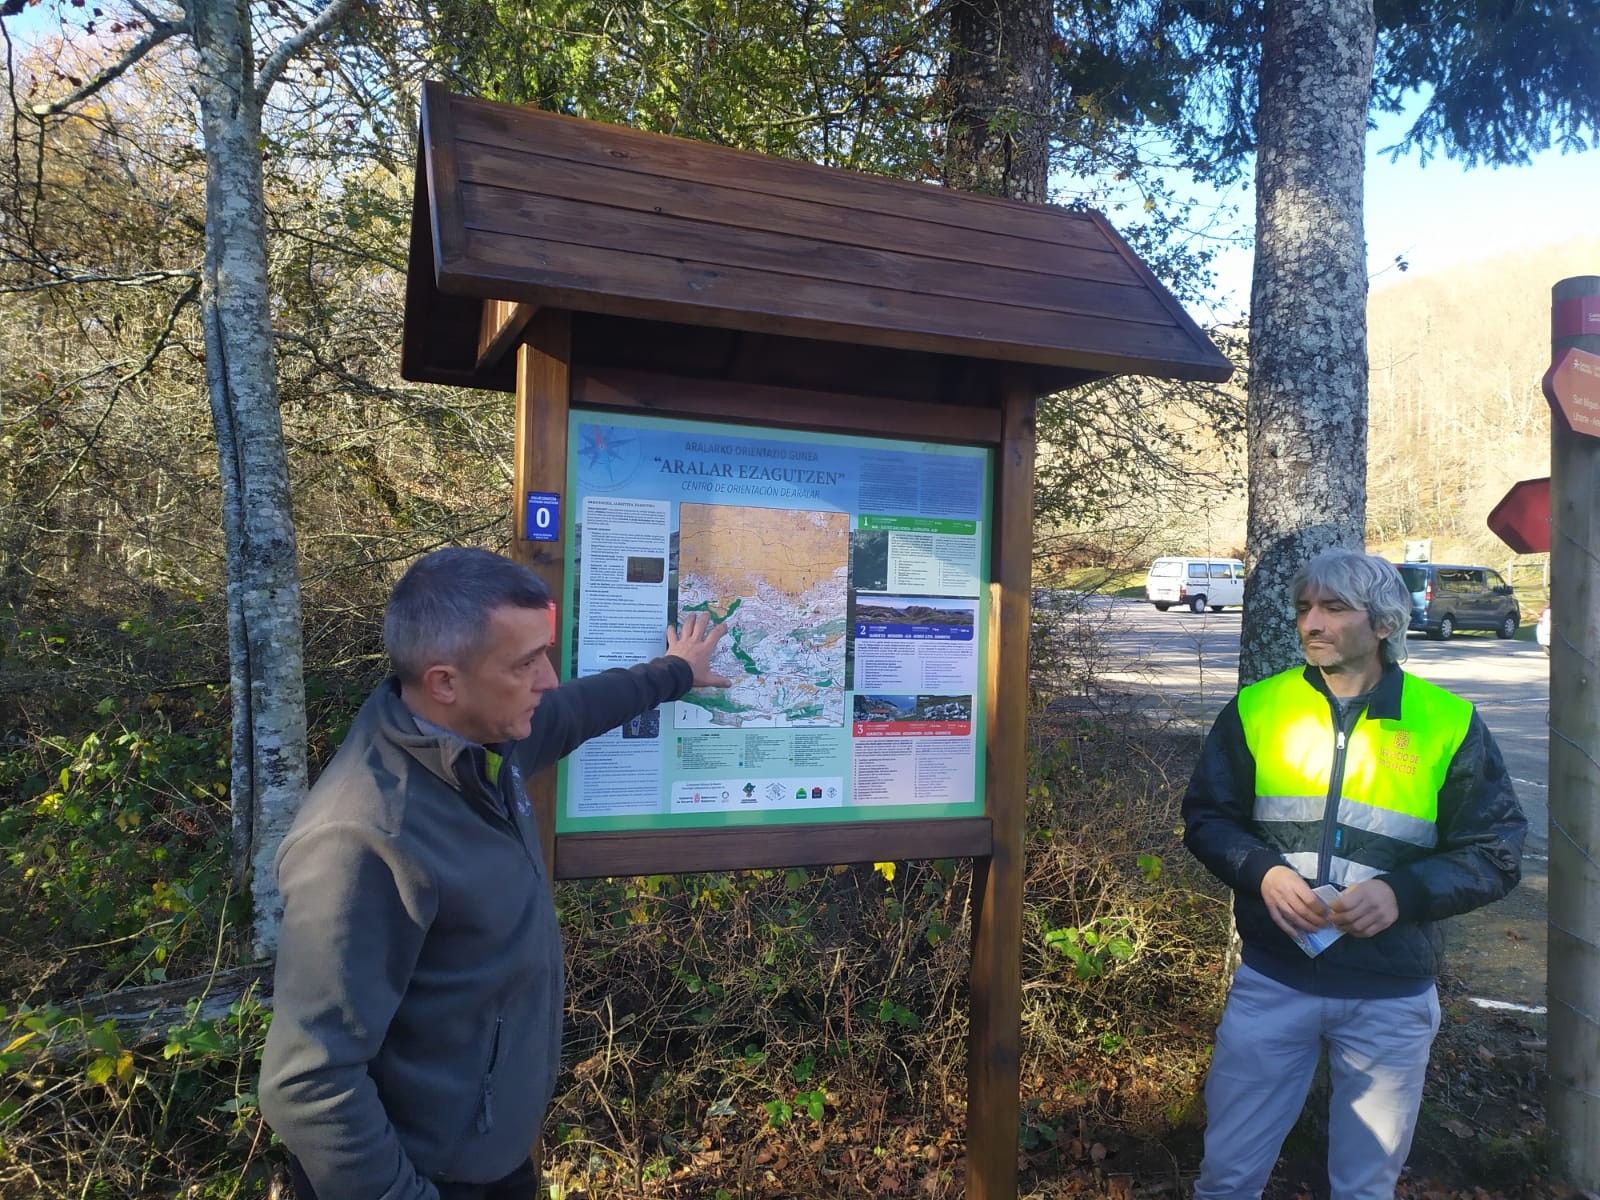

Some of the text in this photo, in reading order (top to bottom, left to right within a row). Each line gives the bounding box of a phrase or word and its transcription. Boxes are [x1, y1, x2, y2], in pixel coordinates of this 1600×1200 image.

[685, 441, 818, 462] ARALARKO ORIENTAZIO GUNEA
[654, 456, 846, 485] “ARALAR EZAGUTZEN”
[681, 480, 713, 492] CENTRO
[715, 482, 725, 493] DE
[536, 507, 550, 528] 0
[864, 516, 868, 526] 1
[860, 625, 866, 635] 2
[857, 724, 864, 734] 3
